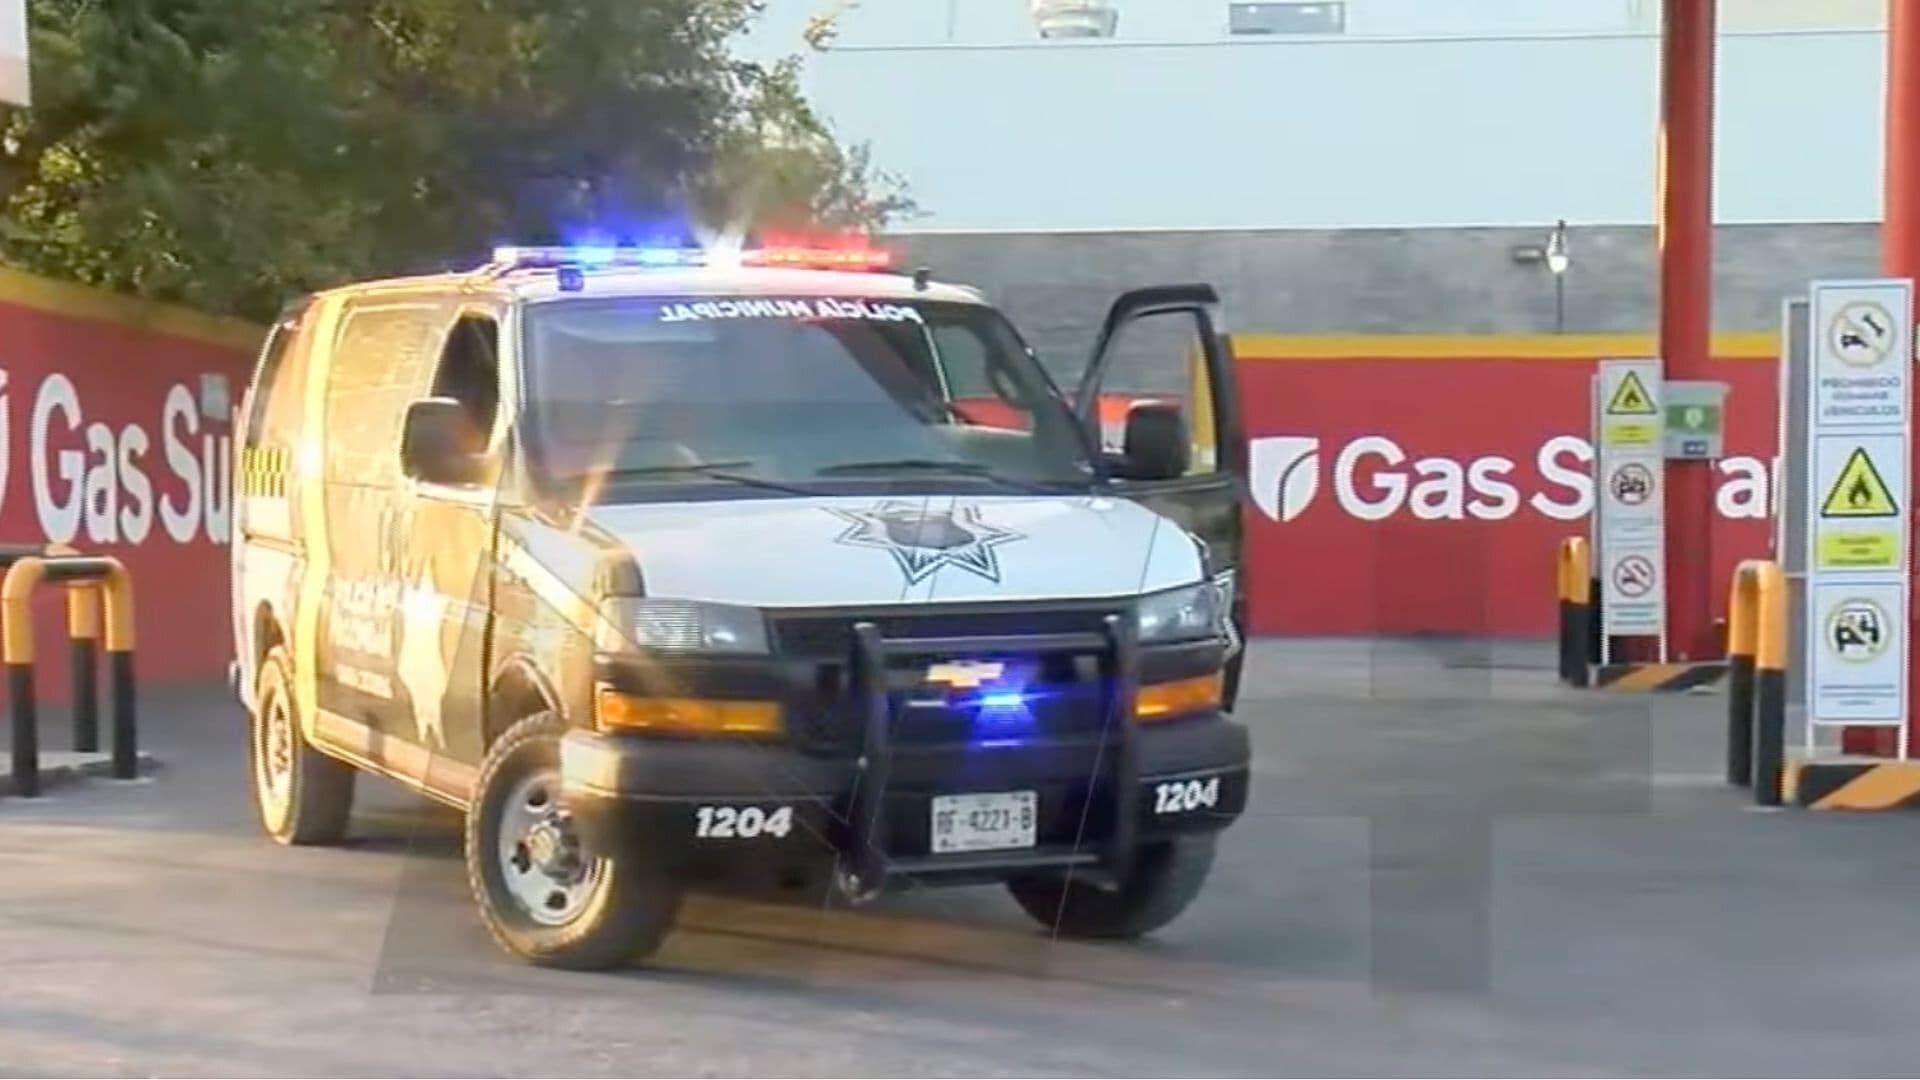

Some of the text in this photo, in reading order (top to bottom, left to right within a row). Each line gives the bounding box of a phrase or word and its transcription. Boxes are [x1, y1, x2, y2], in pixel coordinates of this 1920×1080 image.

[31, 373, 234, 545] Gas Su
[1334, 436, 1520, 521] Gas
[697, 806, 793, 838] 1204
[1155, 778, 1219, 814] 1204
